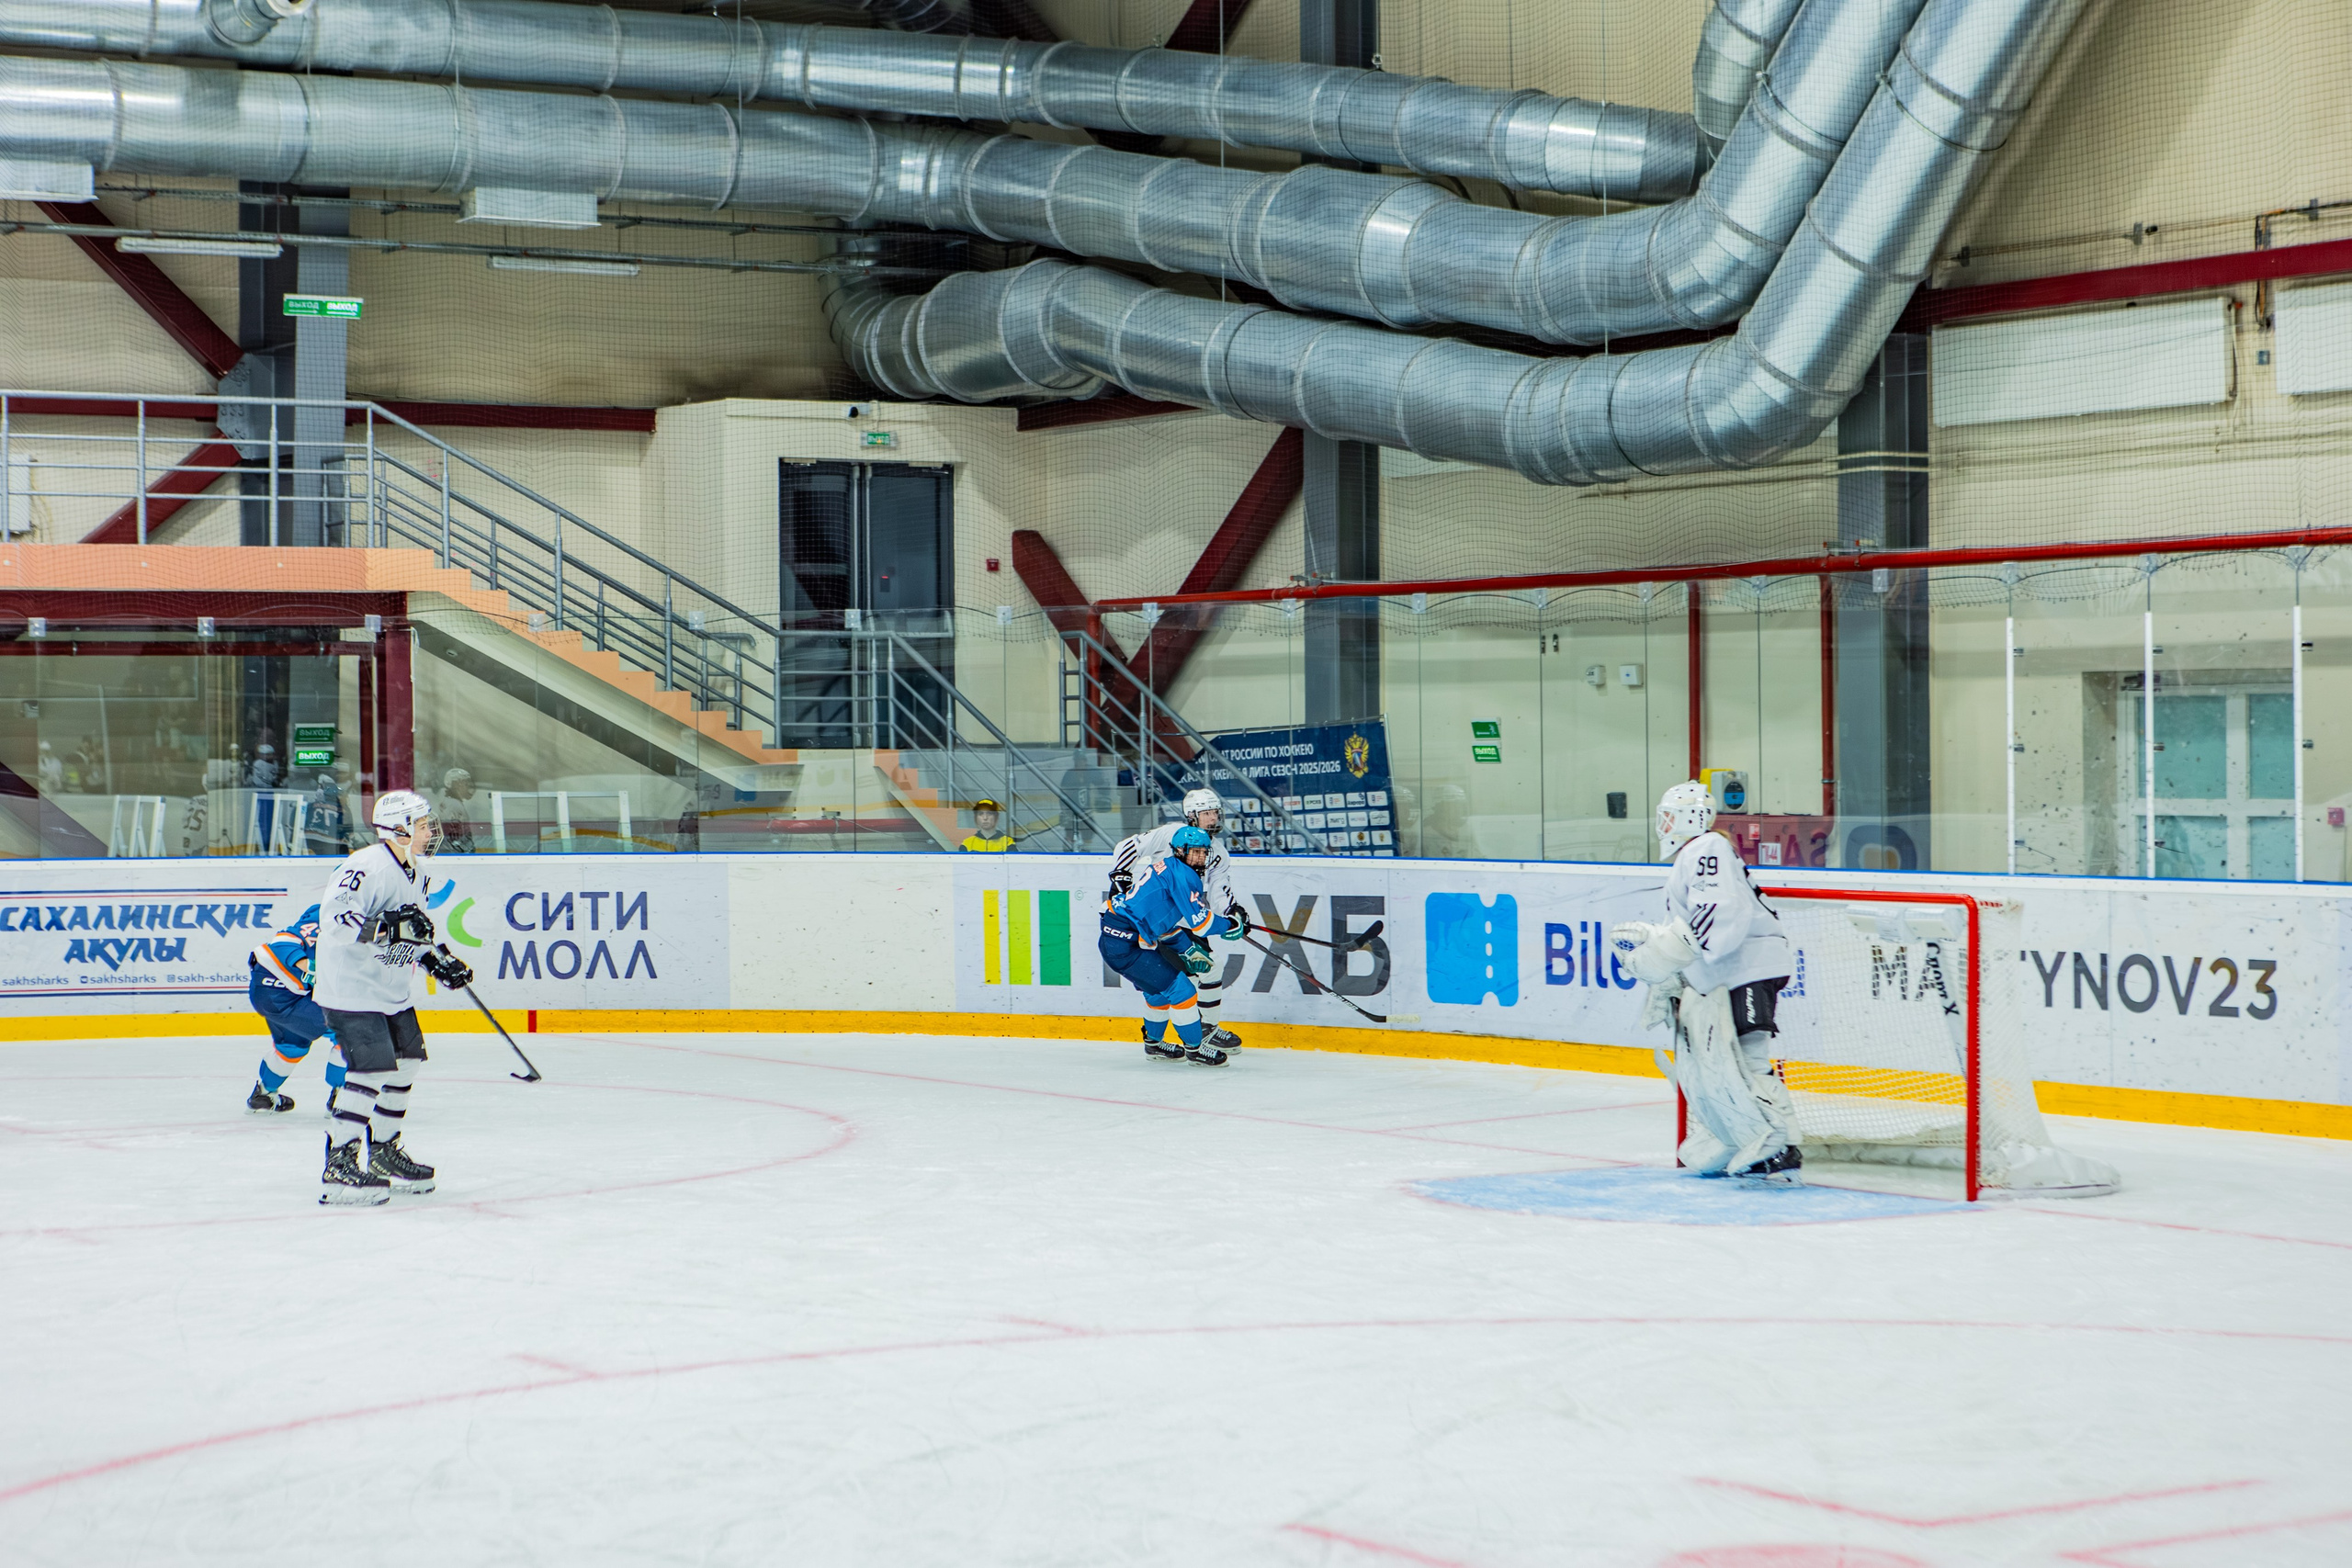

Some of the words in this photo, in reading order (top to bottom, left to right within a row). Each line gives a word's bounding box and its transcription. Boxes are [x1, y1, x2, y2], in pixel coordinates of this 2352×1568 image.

[288, 300, 319, 310] ВЫХОД
[326, 301, 358, 312] ВЫХОД
[299, 752, 330, 761] ВЫХОД
[1231, 746, 1264, 761] РОССИИ
[1264, 746, 1278, 759] ПО
[1249, 765, 1271, 778] ЛИГА
[1298, 760, 1341, 775] 2025/2026
[1696, 855, 1718, 876] 59
[338, 869, 367, 892] 26
[505, 891, 648, 931] СИТИ
[0, 904, 273, 938] САХАЛИНСКИЕ
[1103, 925, 1133, 940] CCM
[63, 937, 187, 972] АКУЛЫ
[498, 940, 658, 980] МОЛЛ
[2, 976, 69, 987] sakhsharks
[90, 974, 156, 984] sakhsharks
